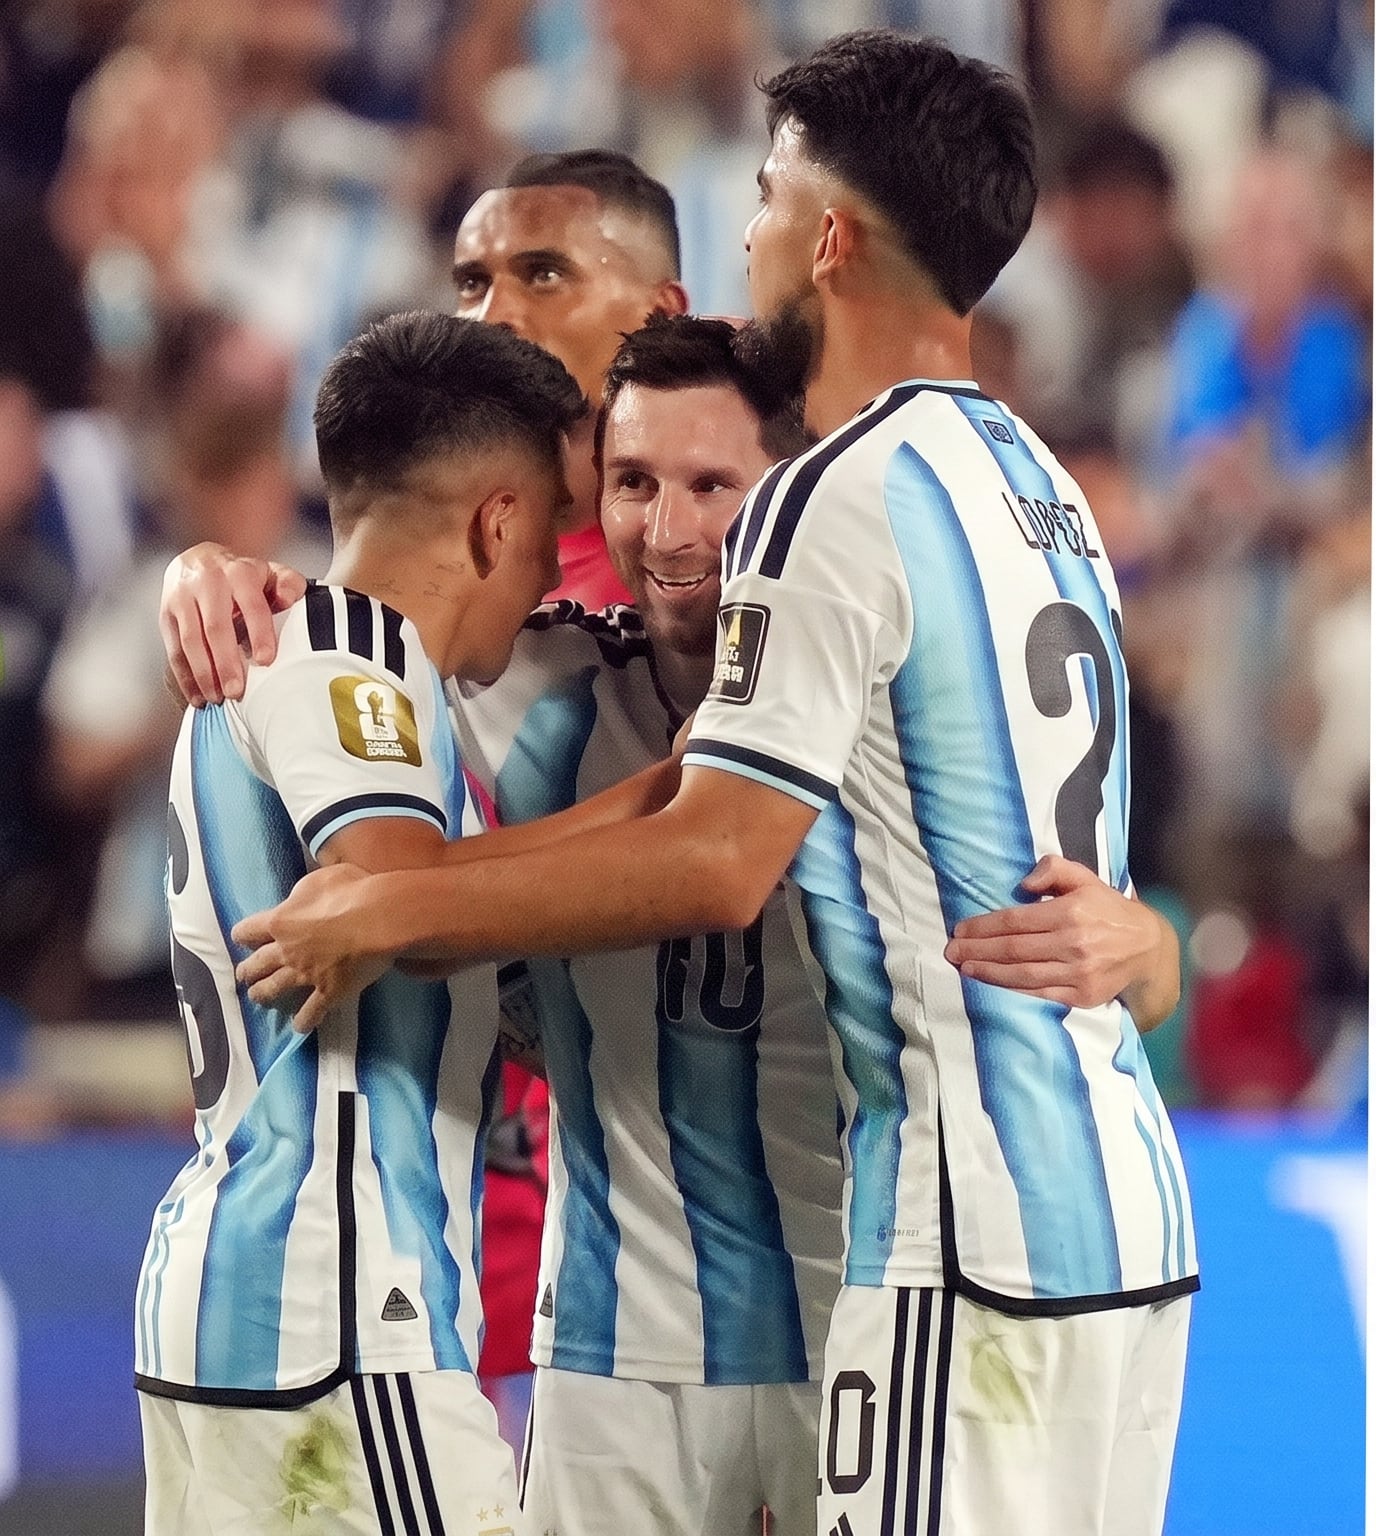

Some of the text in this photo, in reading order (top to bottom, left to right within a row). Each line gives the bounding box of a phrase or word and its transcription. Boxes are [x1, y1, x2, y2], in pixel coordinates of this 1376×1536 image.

[1001, 491, 1100, 559] LOPEZ
[1025, 601, 1123, 880] 2
[817, 1370, 877, 1495] 0
